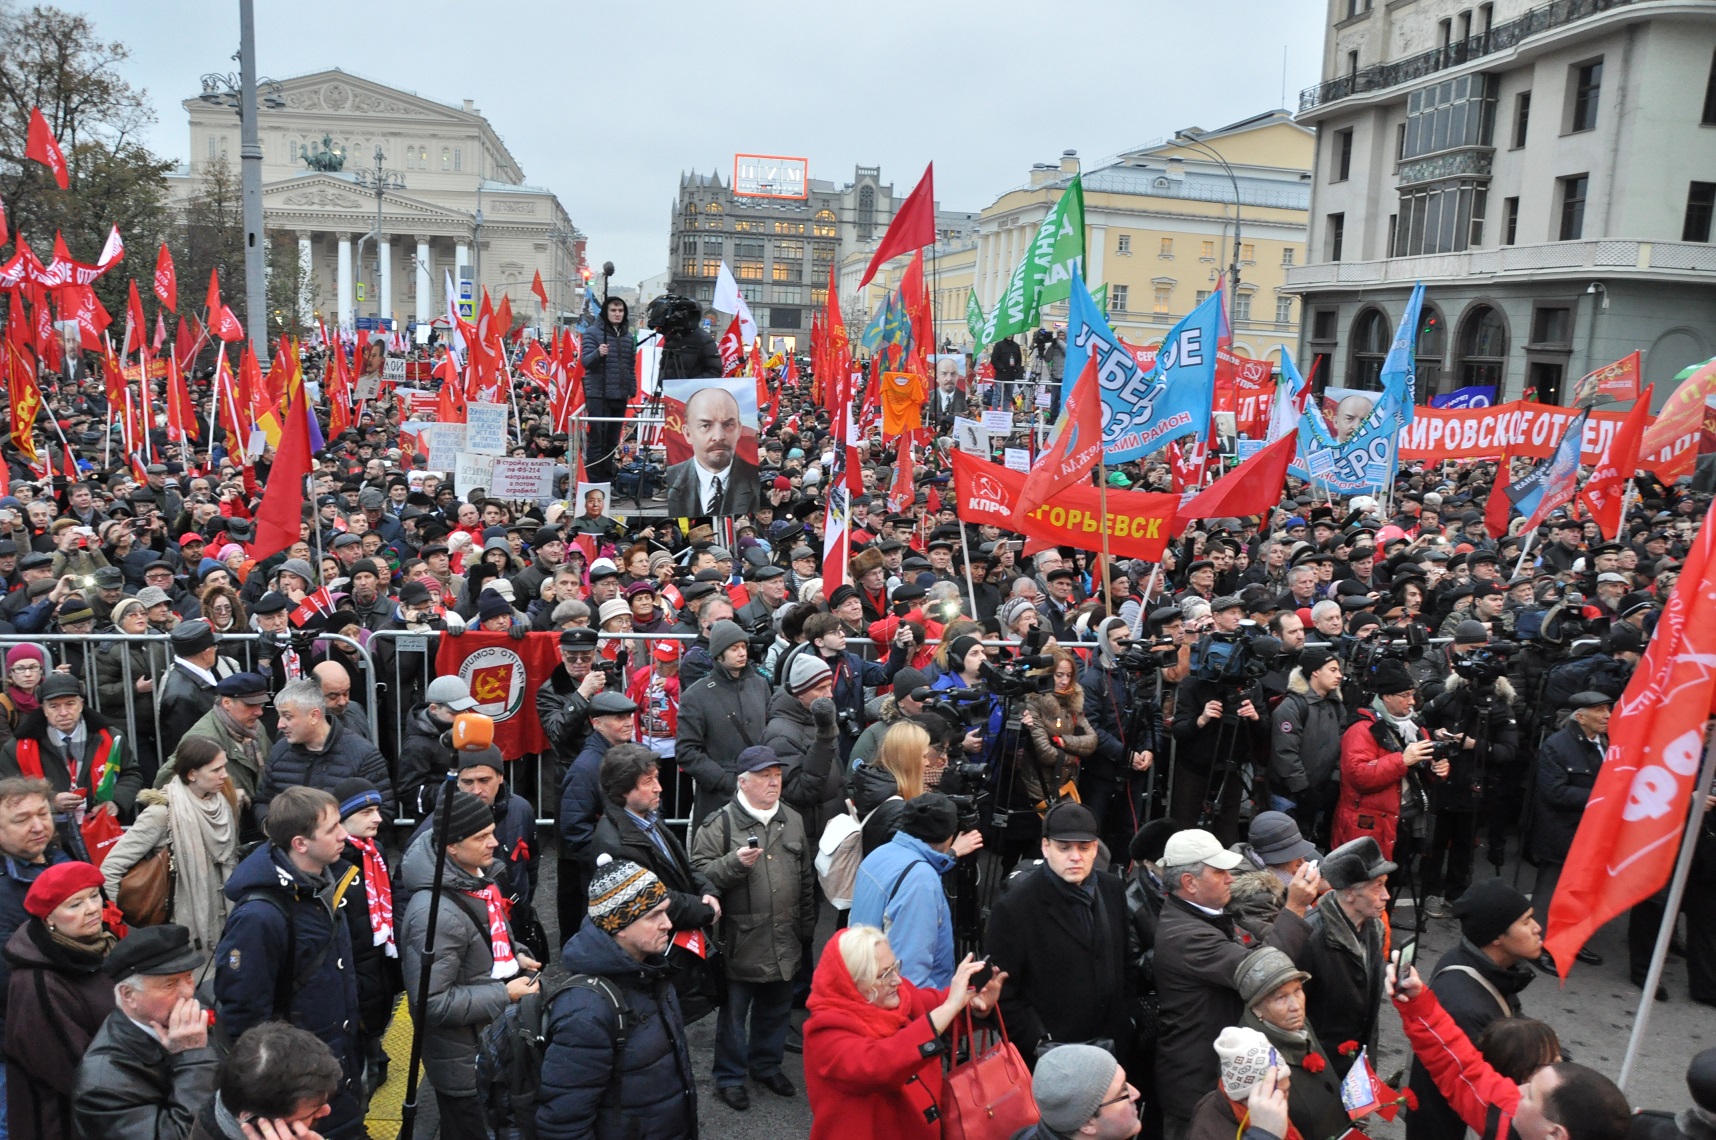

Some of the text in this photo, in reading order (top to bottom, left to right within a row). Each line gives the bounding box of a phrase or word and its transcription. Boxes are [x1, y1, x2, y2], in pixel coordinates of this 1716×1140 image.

[1141, 411, 1192, 444] РАЙОН
[1398, 410, 1534, 450] КИРОВСКОЕ
[502, 459, 529, 467] стройку
[968, 497, 1012, 517] КПРФ
